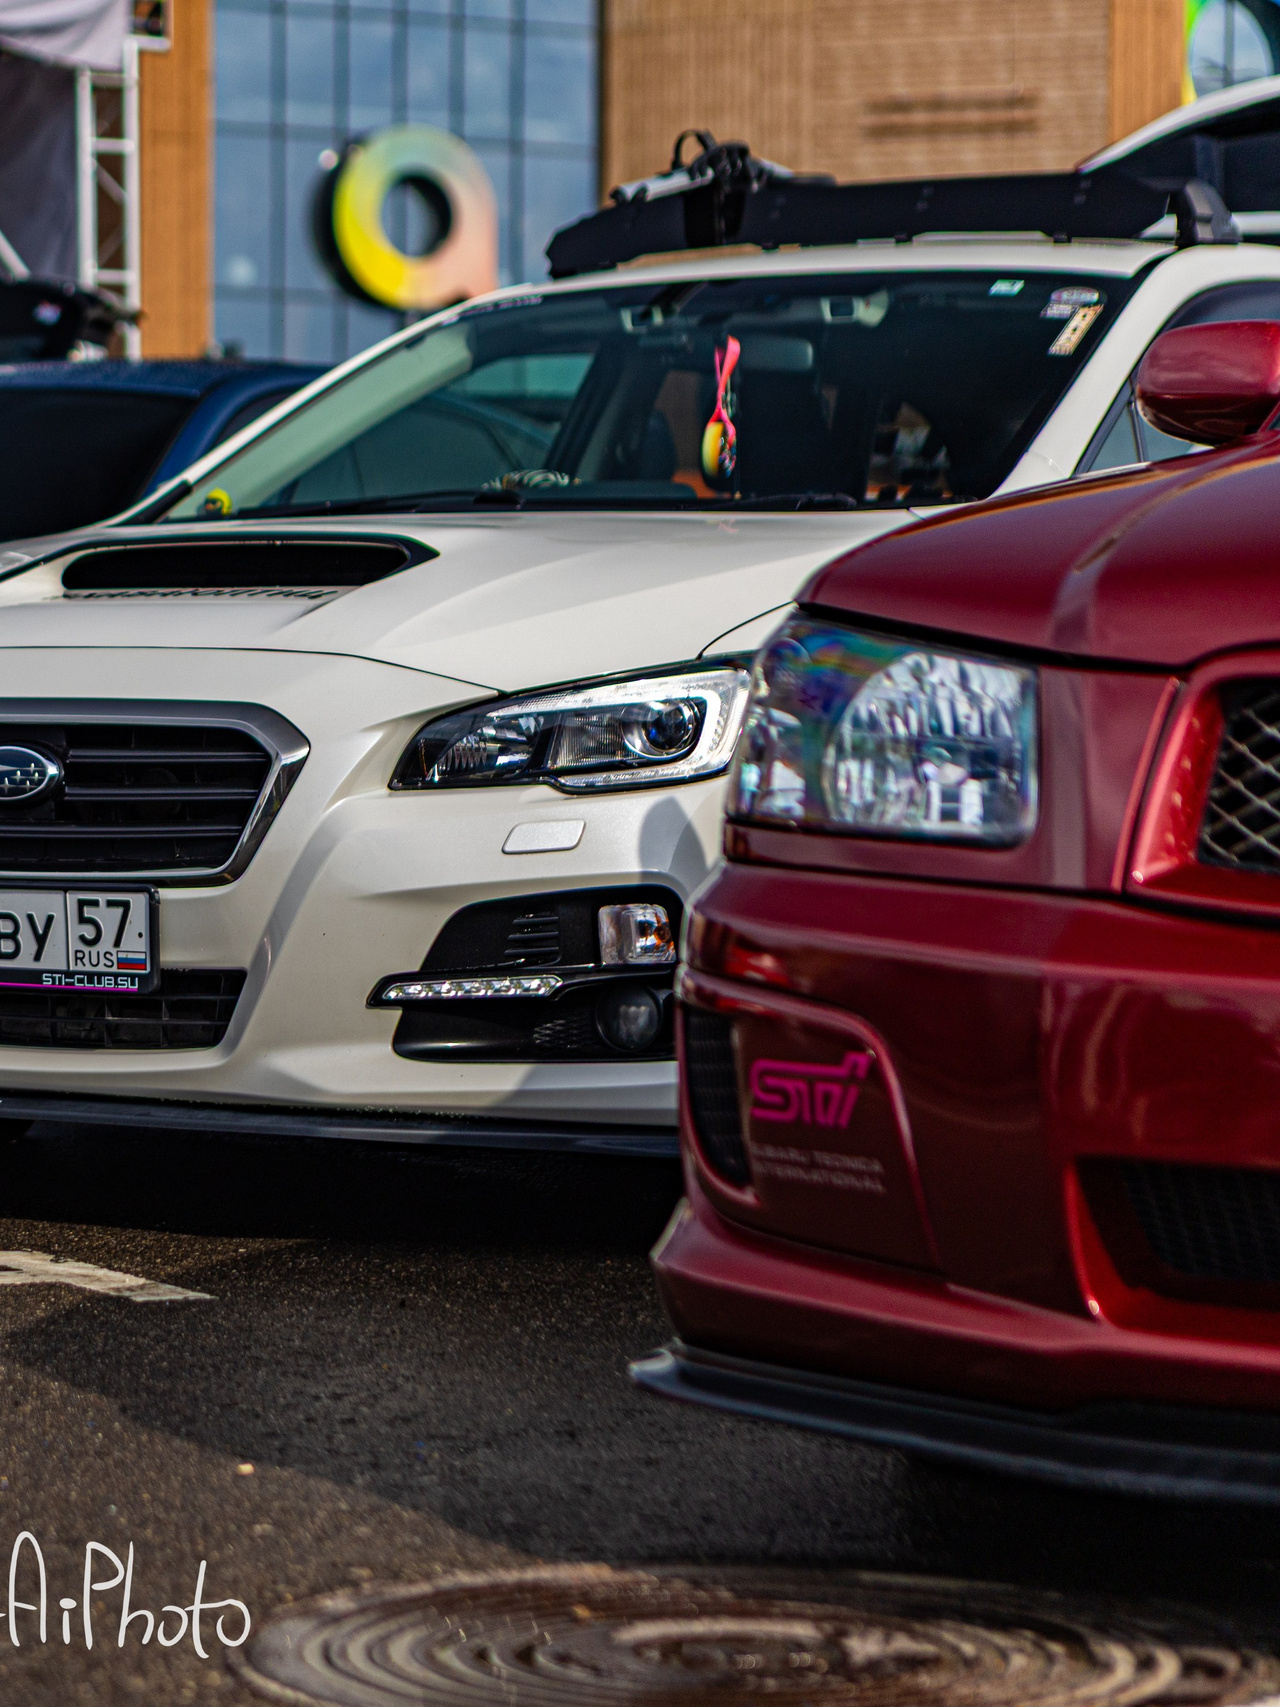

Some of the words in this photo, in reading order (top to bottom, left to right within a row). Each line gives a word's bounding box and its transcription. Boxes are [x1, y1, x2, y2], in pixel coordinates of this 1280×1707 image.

[77, 897, 132, 948] 57
[74, 949, 115, 968] RUS
[42, 973, 139, 989] STI-CLUB.SU
